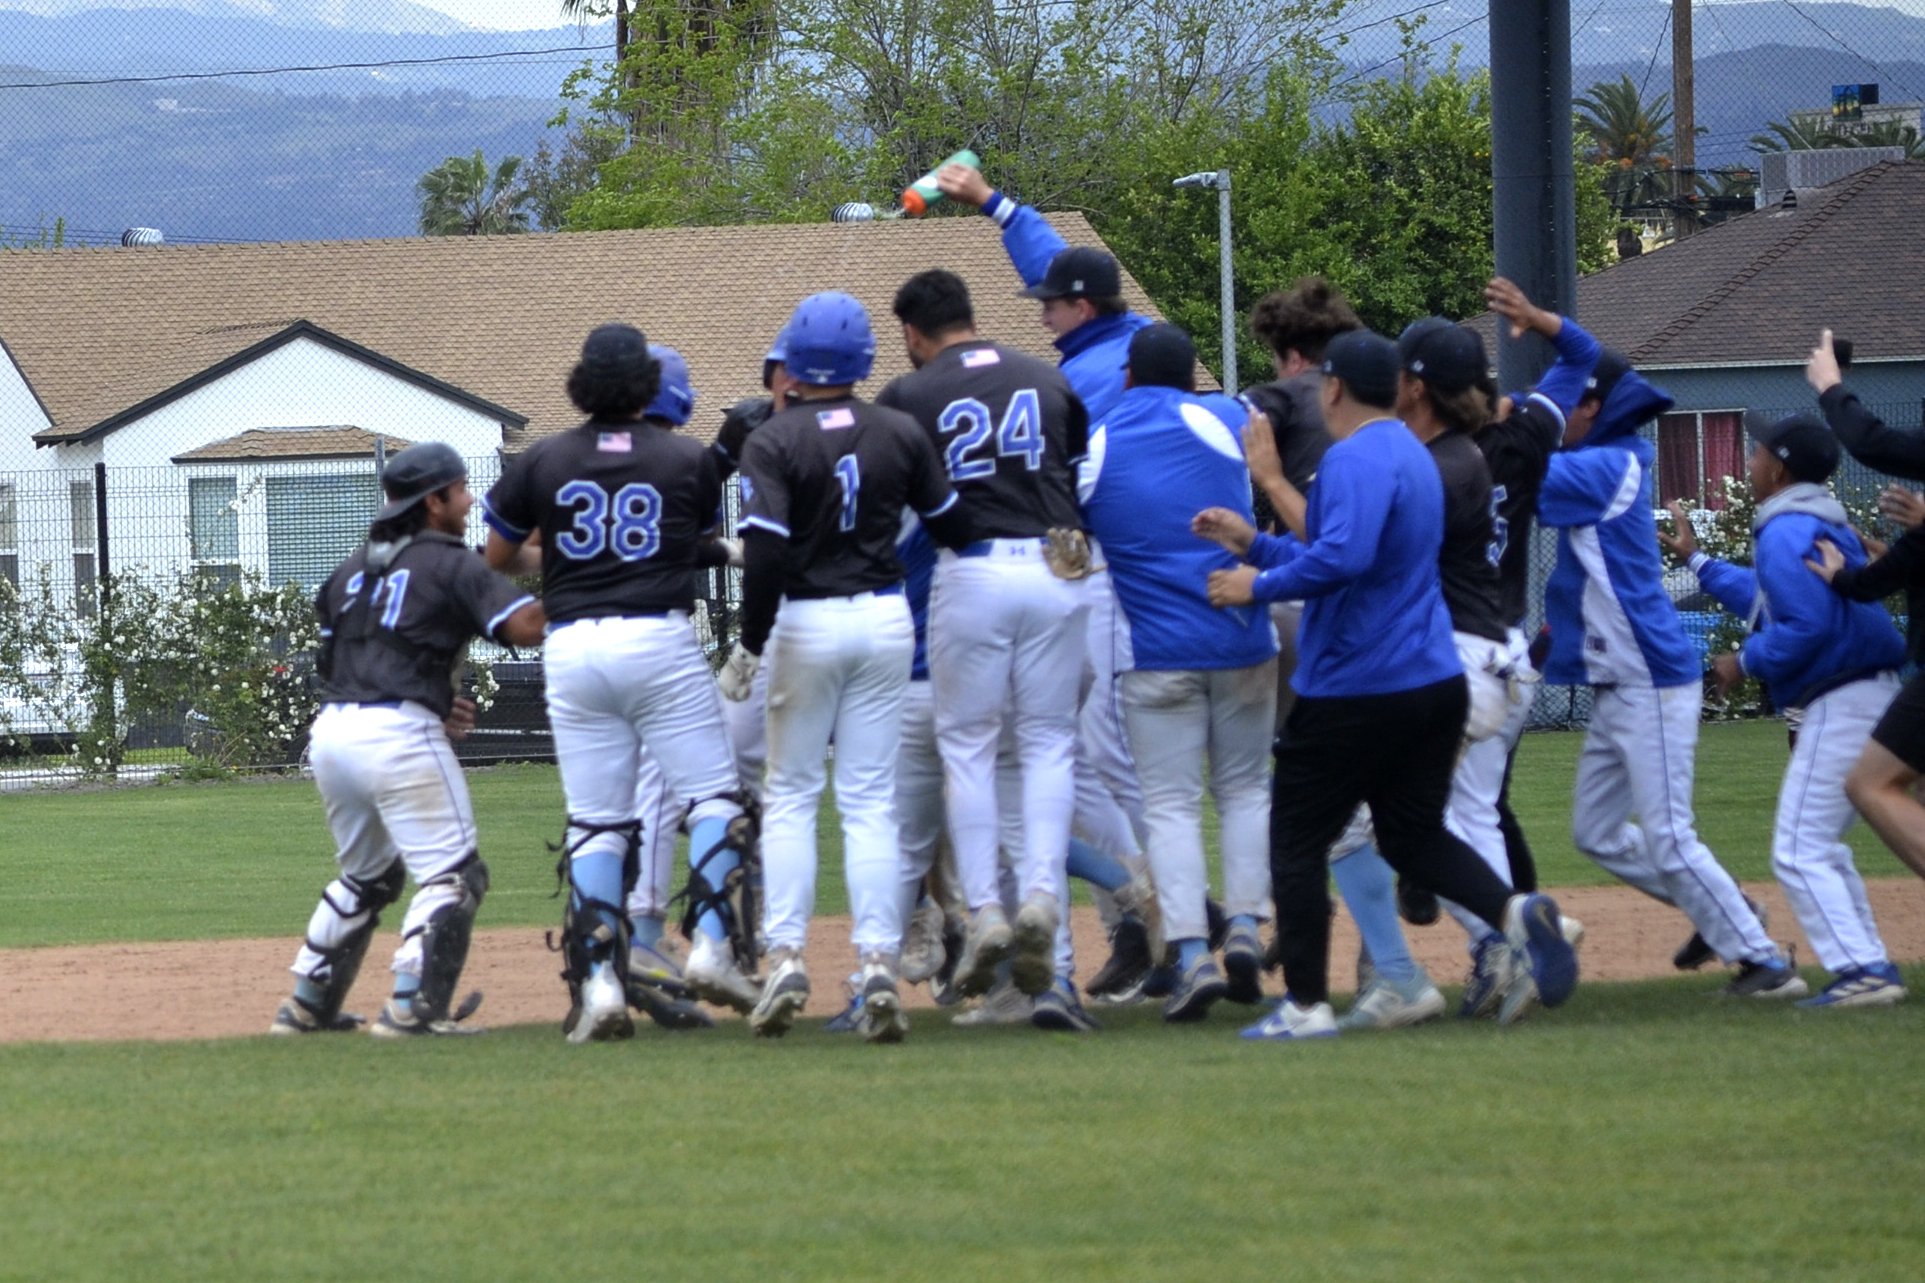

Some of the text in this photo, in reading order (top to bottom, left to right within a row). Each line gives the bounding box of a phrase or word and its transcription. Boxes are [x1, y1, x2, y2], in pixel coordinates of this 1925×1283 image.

[937, 388, 1045, 480] 24
[555, 480, 662, 561] 38
[833, 453, 860, 532] 1
